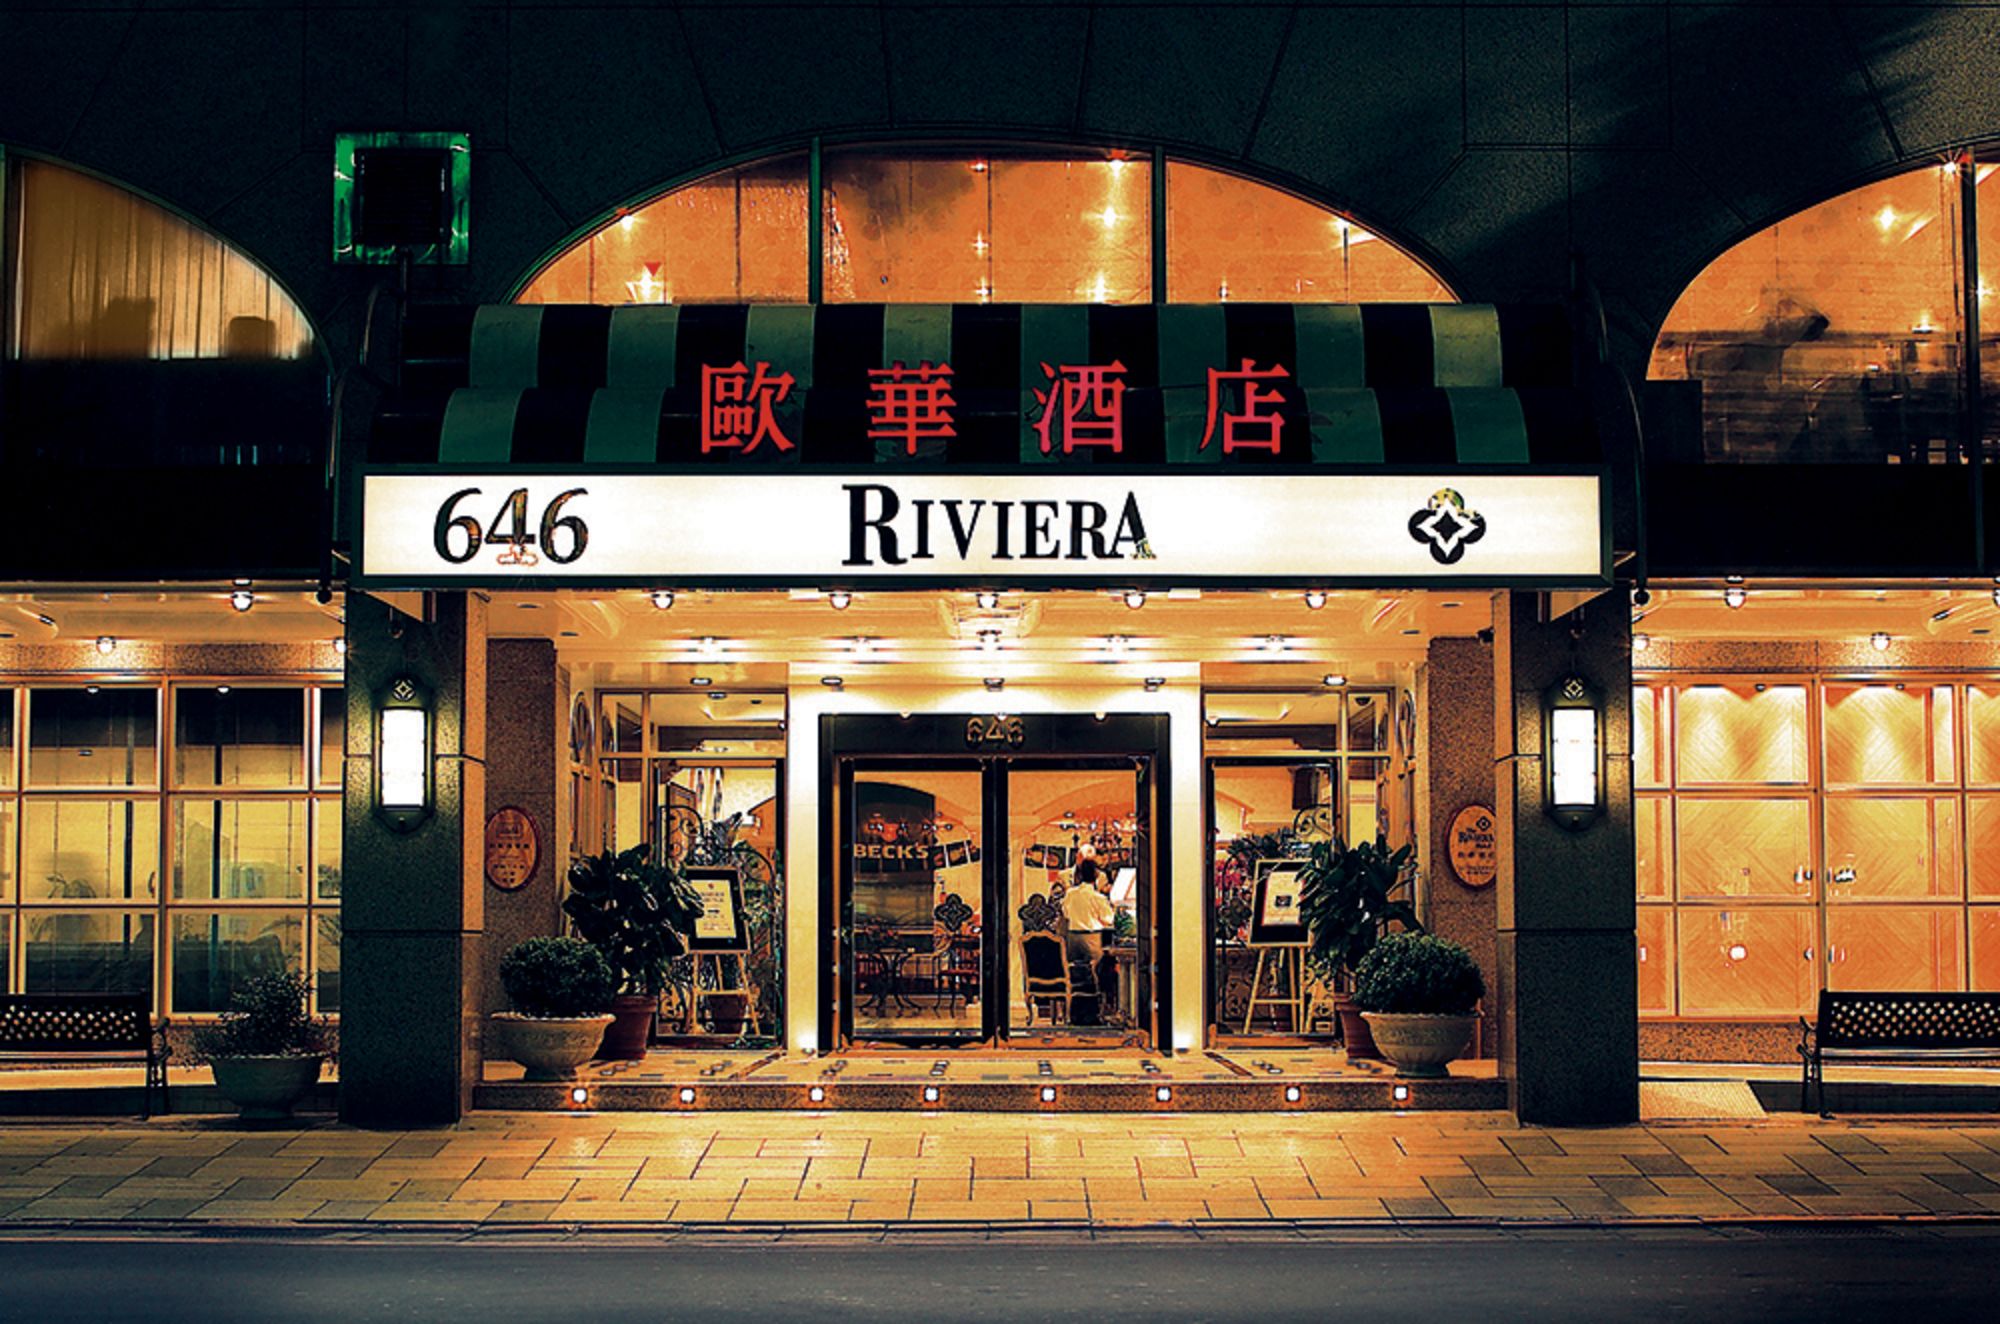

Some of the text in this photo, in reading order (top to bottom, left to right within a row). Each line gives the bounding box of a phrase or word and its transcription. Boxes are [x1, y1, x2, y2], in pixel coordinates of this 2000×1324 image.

[700, 358, 1290, 455] 歐華酒店
[433, 487, 589, 564] 646
[841, 483, 1157, 566] RIVIERA
[966, 717, 1024, 745] 646
